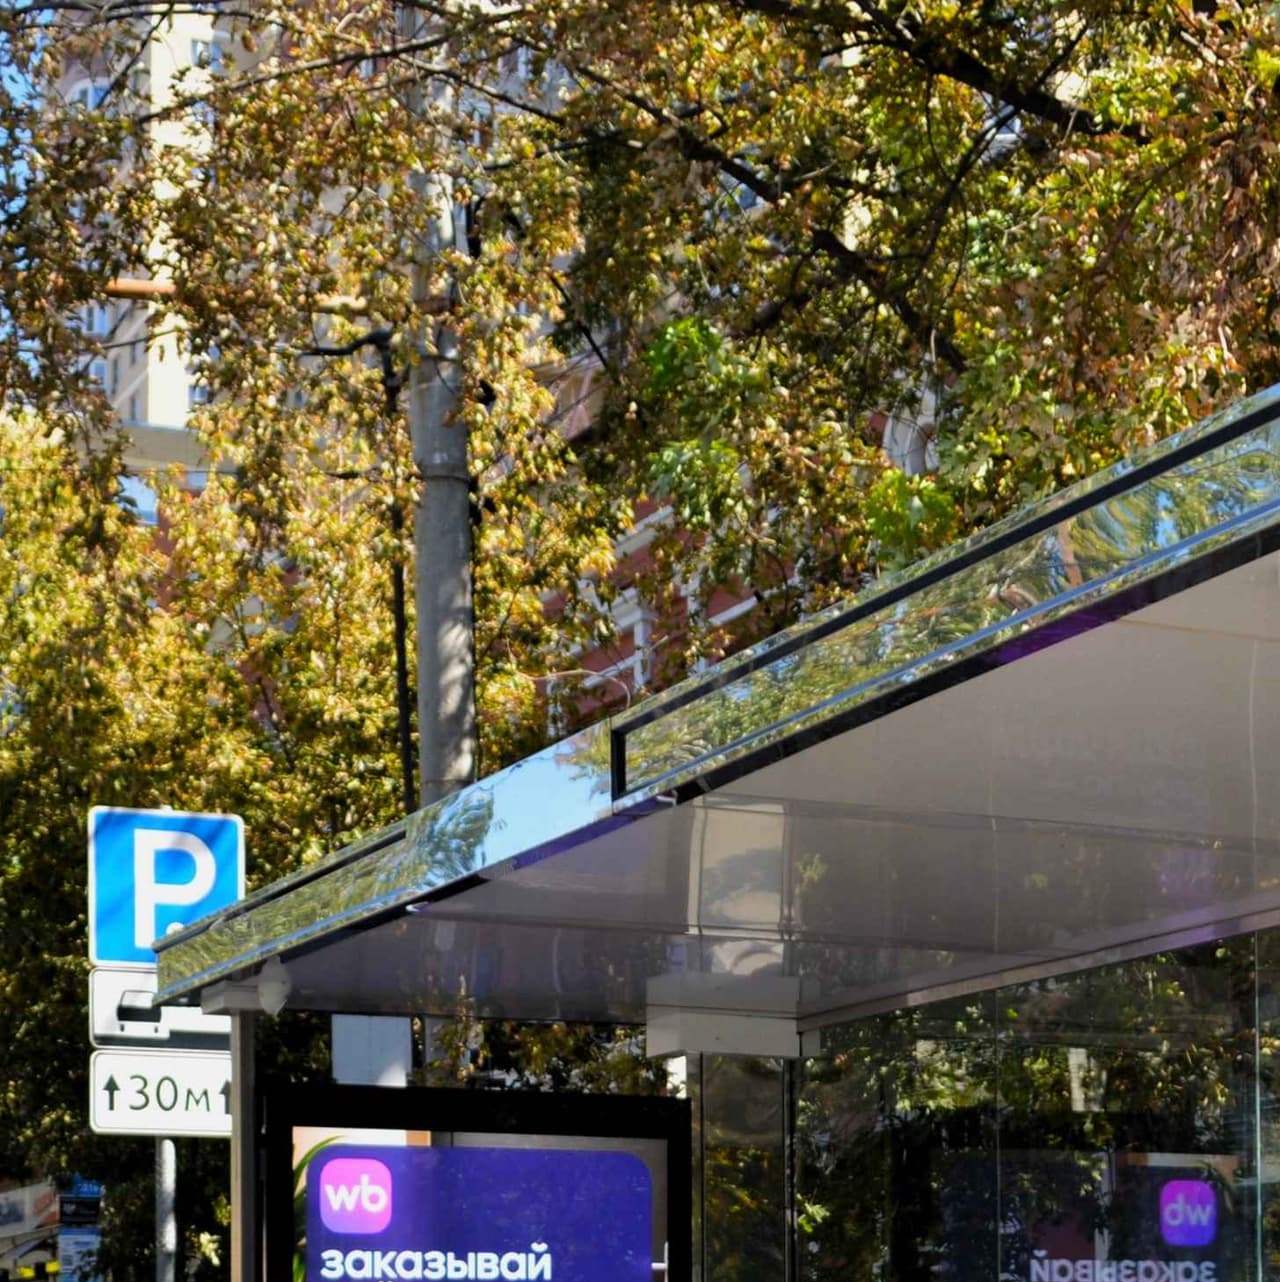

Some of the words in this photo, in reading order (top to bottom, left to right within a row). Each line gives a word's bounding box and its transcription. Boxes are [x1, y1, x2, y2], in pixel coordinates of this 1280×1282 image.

[134, 828, 216, 949] P
[325, 1174, 387, 1212] wb
[320, 1242, 552, 1281] заказывай
